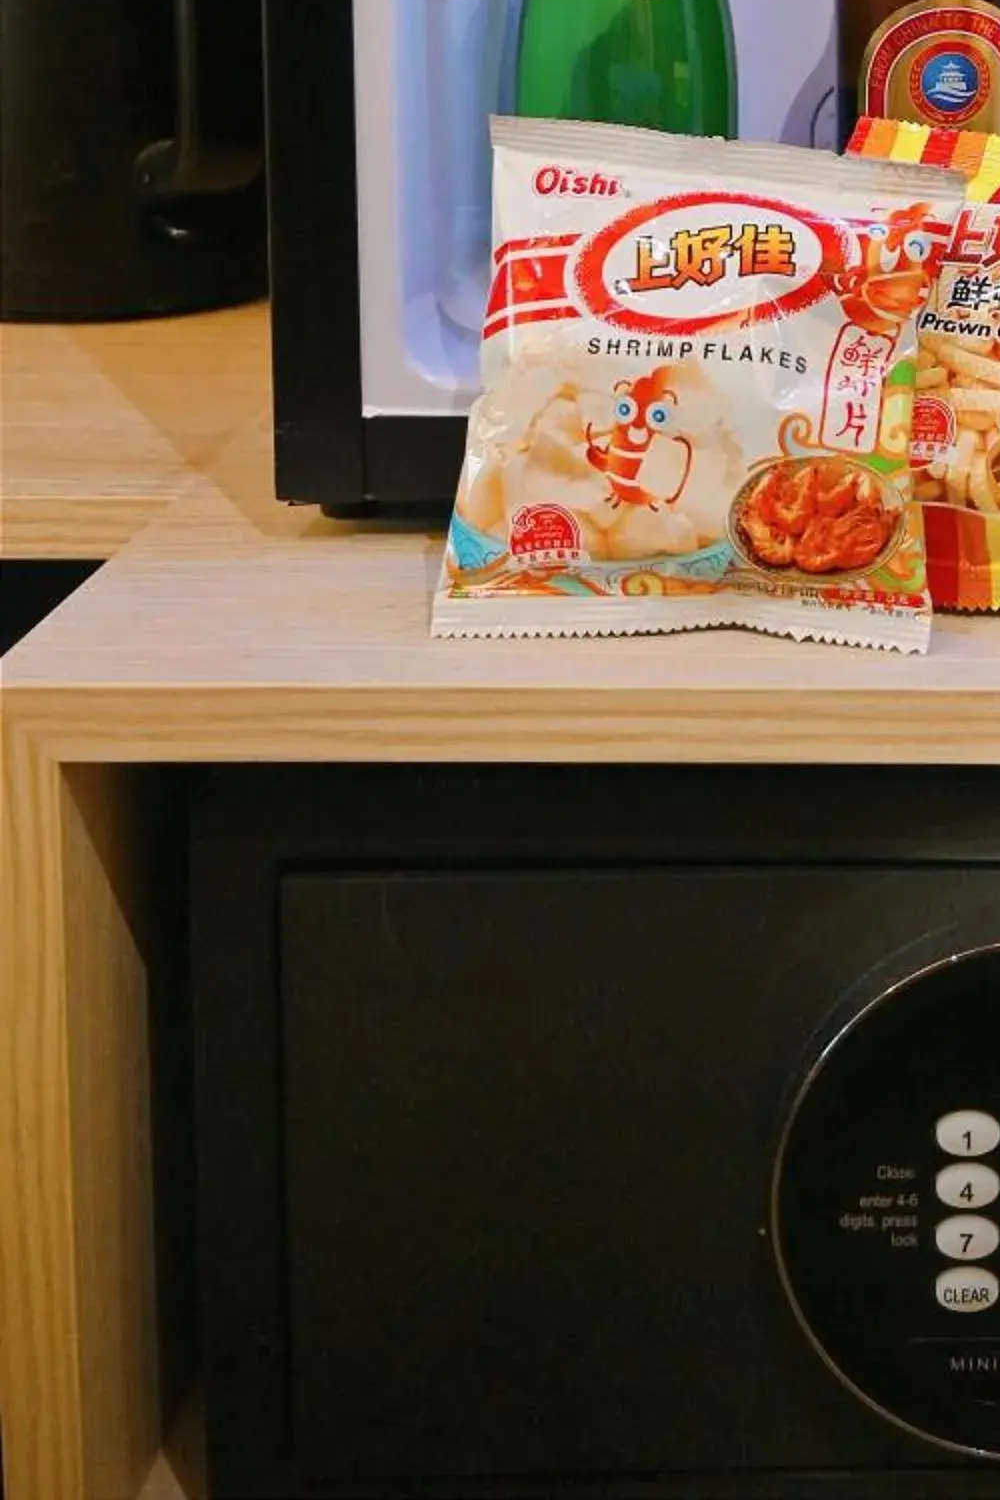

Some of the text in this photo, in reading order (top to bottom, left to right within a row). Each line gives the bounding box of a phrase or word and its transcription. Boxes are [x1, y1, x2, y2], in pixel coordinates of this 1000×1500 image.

[534, 164, 621, 197] Oishi
[628, 223, 797, 292] 上好佳
[920, 313, 991, 338] Prawn
[587, 337, 808, 374] SHRIMP FLAKES
[960, 1130, 973, 1151] 1
[859, 1192, 919, 1208] enter 4-6
[960, 1183, 974, 1203] 4
[882, 1214, 919, 1232] press
[891, 1231, 919, 1248] lock
[960, 1234, 973, 1253] 7
[943, 1287, 990, 1305] CLEAR
